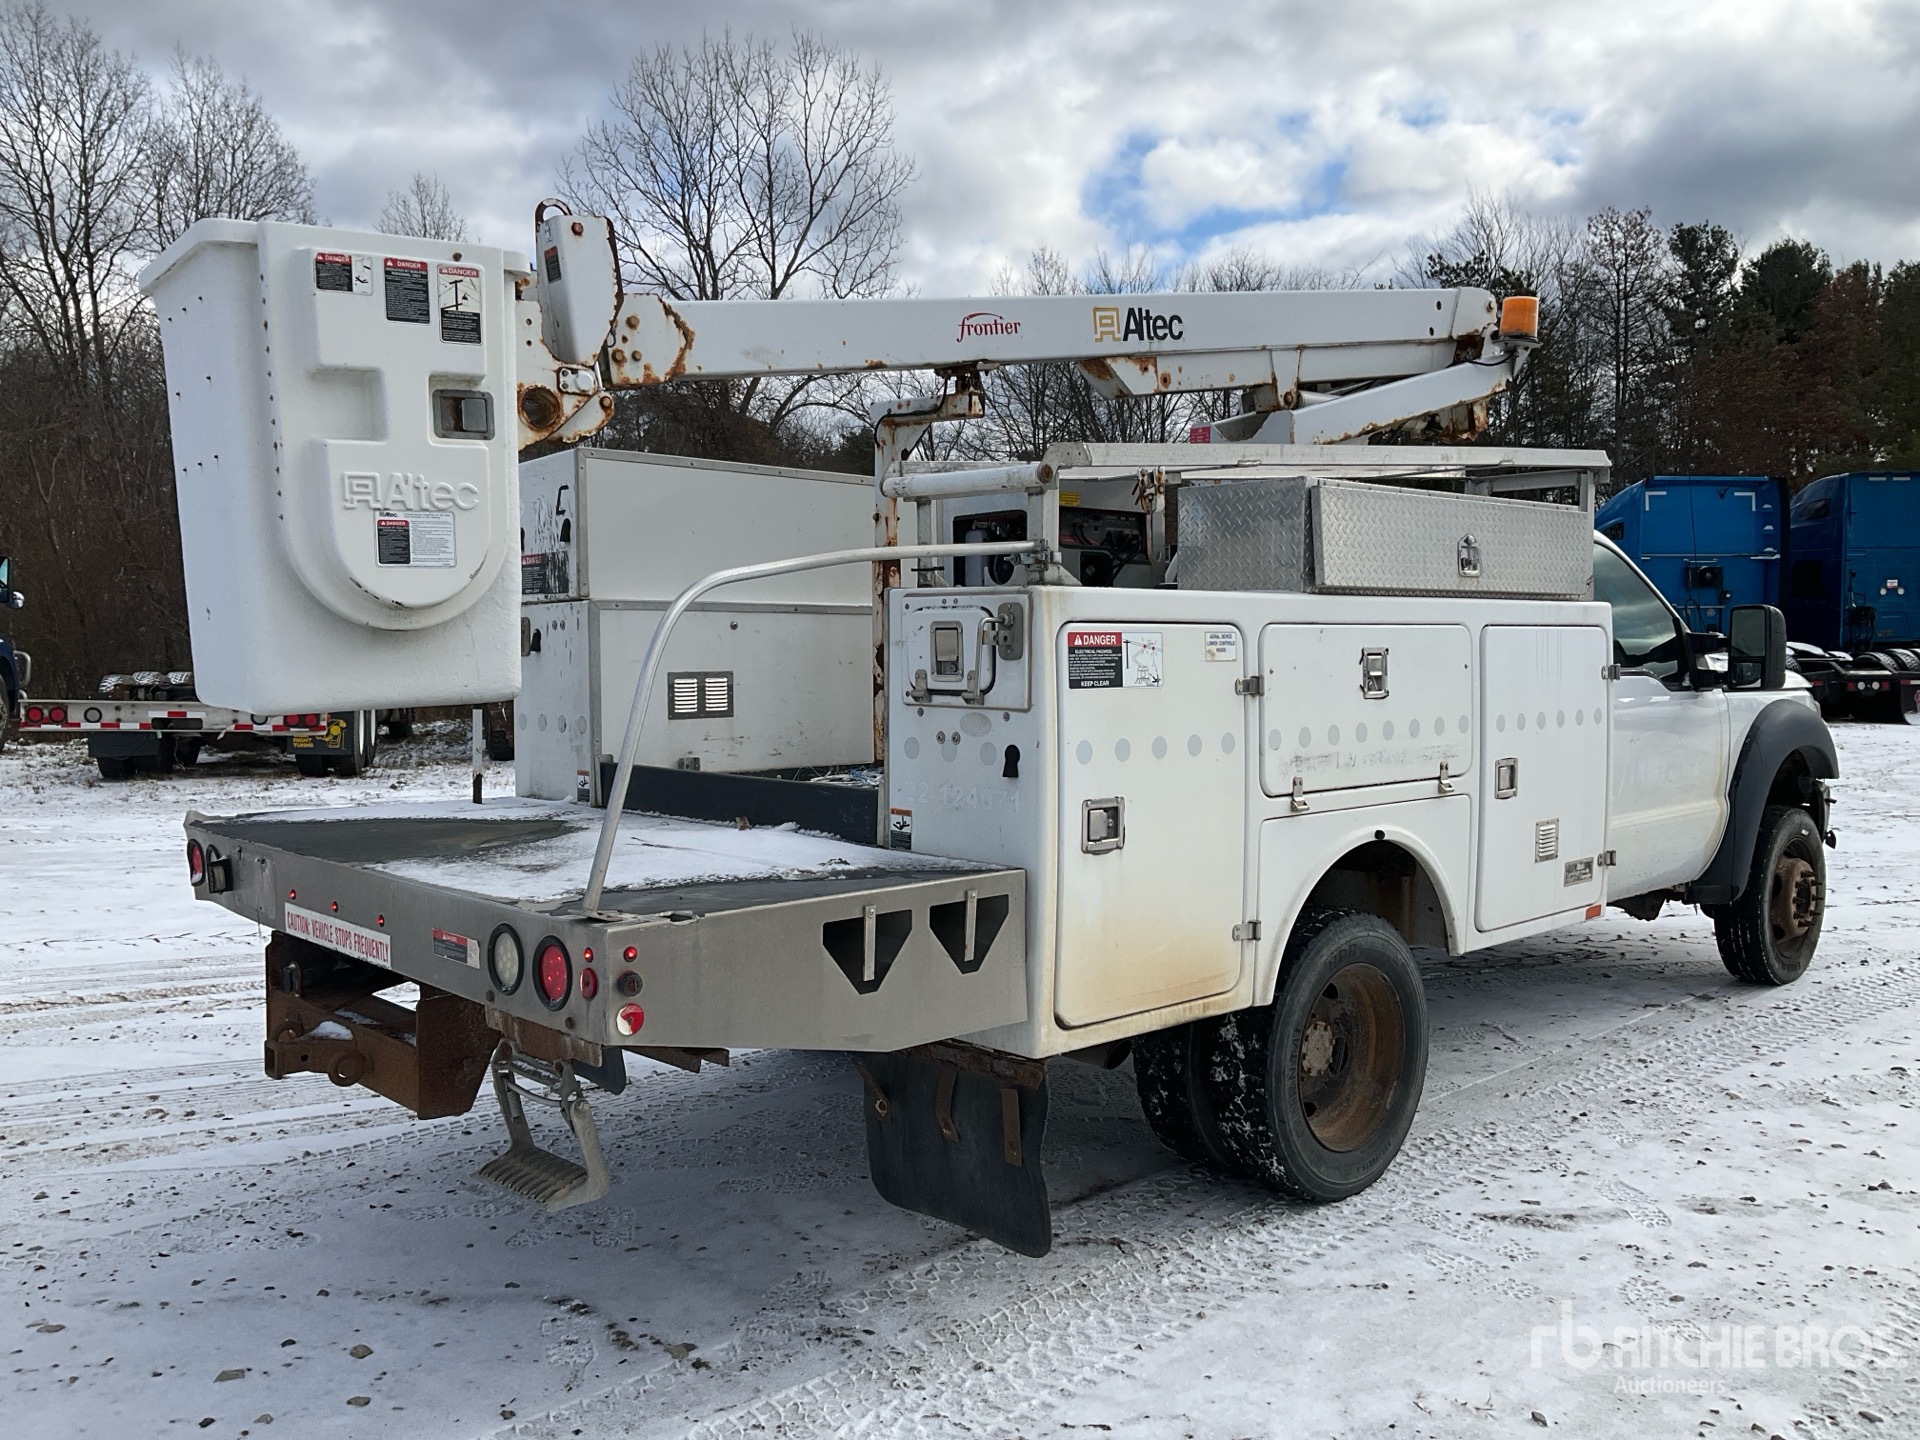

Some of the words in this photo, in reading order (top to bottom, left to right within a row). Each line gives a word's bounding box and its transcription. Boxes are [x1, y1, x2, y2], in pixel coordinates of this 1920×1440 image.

[325, 255, 350, 263] DANGER
[397, 261, 421, 269] DANGER
[448, 268, 477, 277] DANGER
[956, 312, 1021, 343] frontier
[1123, 307, 1184, 342] Altec
[384, 472, 480, 511] Altec
[1083, 634, 1117, 645] DANGER
[311, 919, 334, 943] VEHICLE
[334, 927, 352, 950] STOPS
[354, 933, 389, 962] FREQUENTLY
